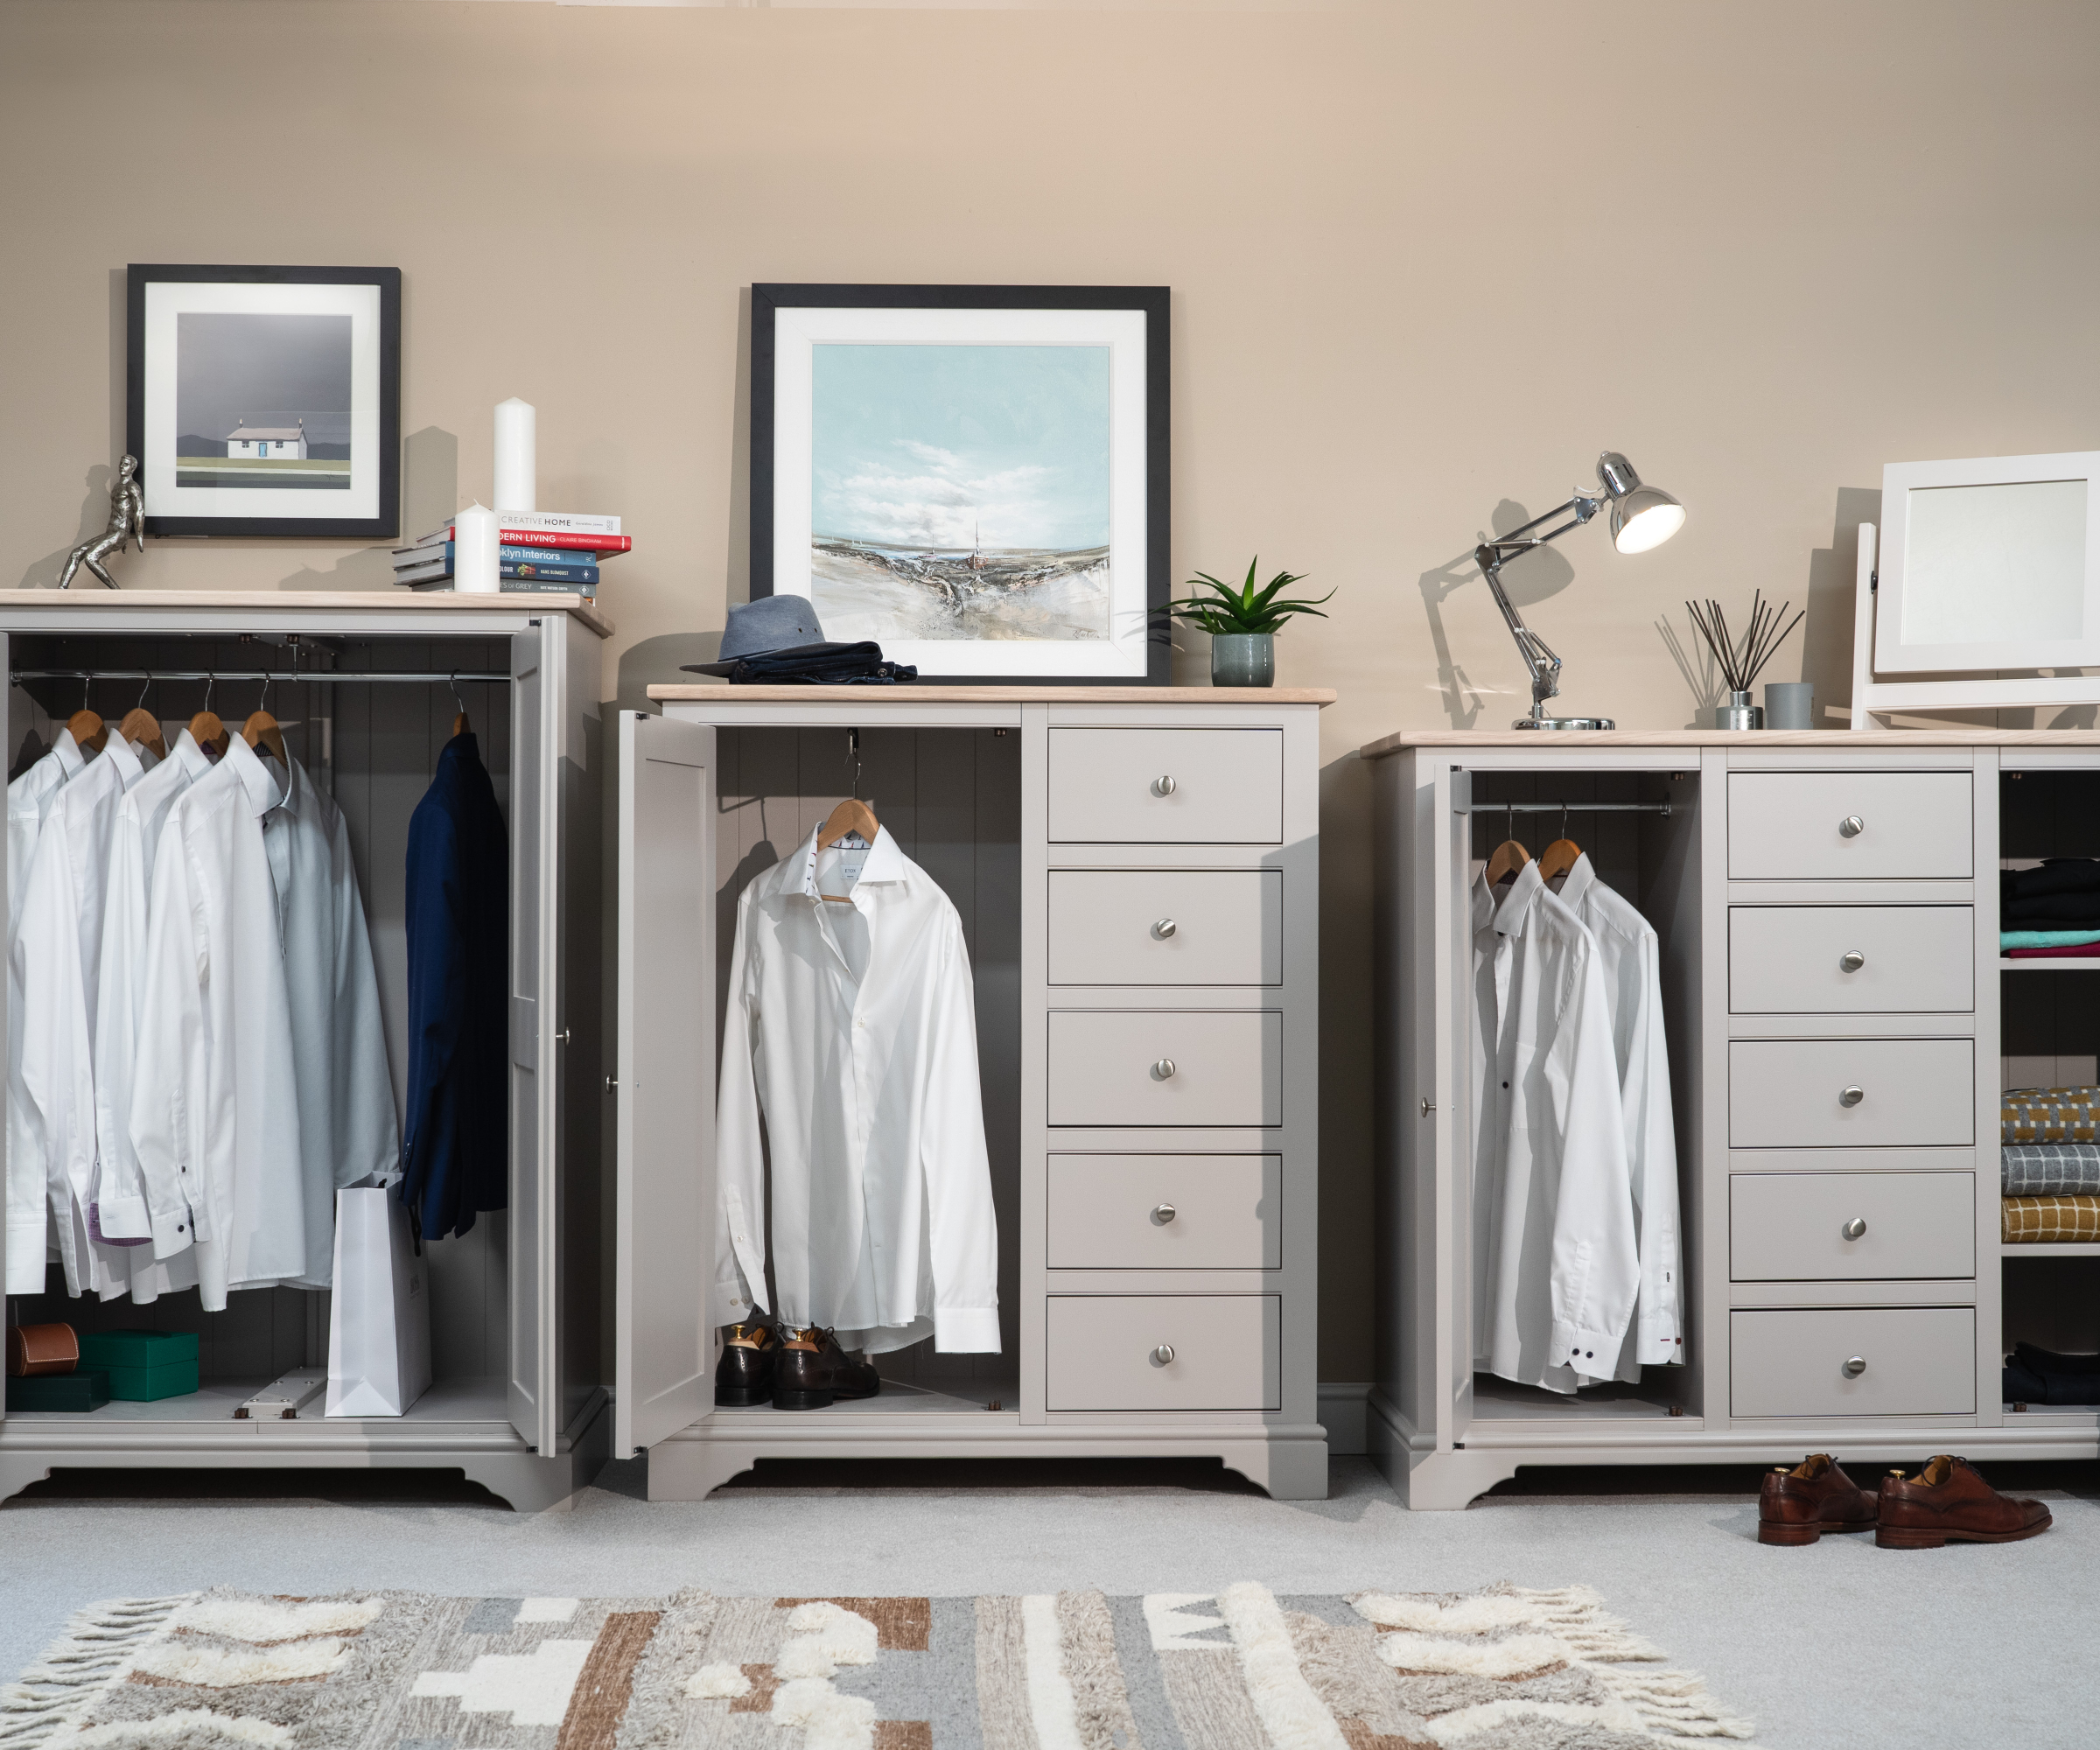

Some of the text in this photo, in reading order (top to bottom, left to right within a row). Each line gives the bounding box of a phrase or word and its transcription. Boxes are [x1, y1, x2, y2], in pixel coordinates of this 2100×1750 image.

[501, 515, 542, 525] CREATIVE
[545, 518, 571, 527] HOME
[499, 532, 522, 541] DERN
[525, 534, 556, 543] LIVING
[499, 548, 560, 560] oklyn Interiors
